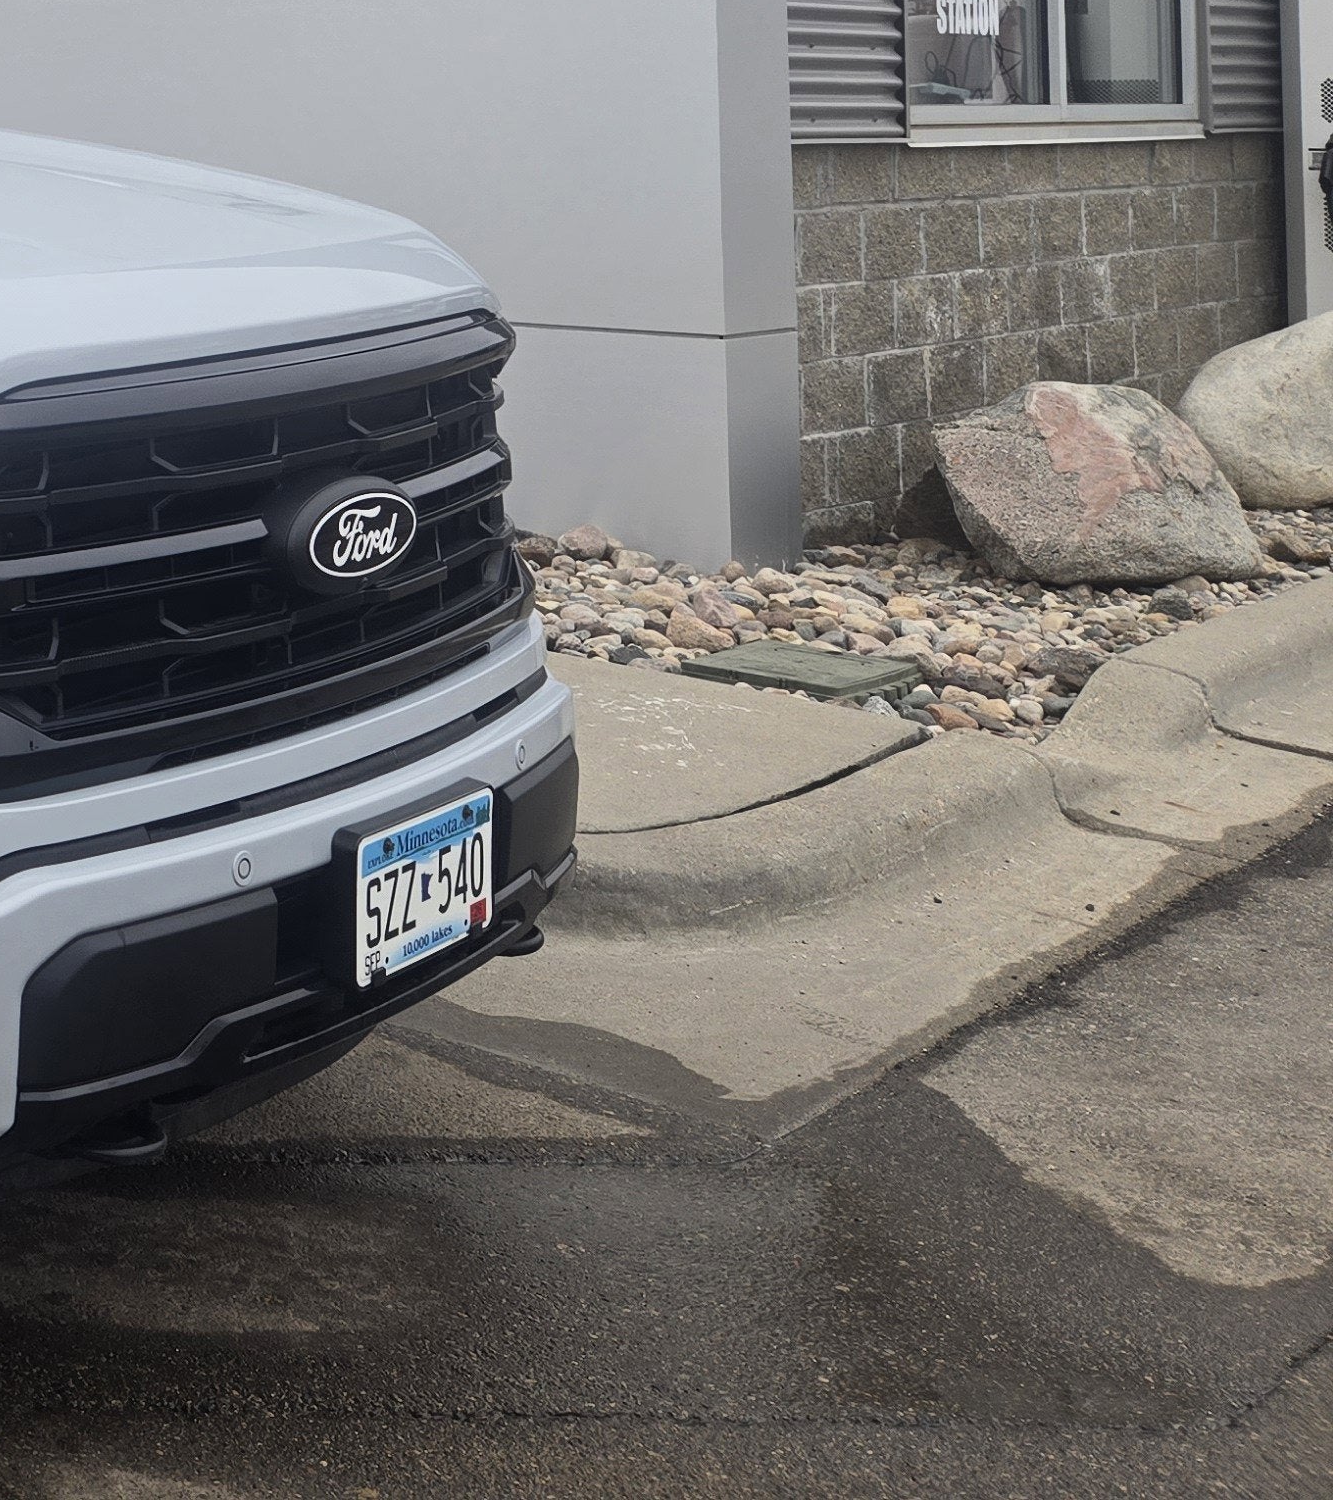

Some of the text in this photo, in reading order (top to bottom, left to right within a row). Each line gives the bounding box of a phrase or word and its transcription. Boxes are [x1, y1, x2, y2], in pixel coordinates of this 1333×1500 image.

[332, 503, 399, 567] Ford
[366, 831, 485, 949] SZZ 540
[402, 924, 453, 957] 10,000 lakes
